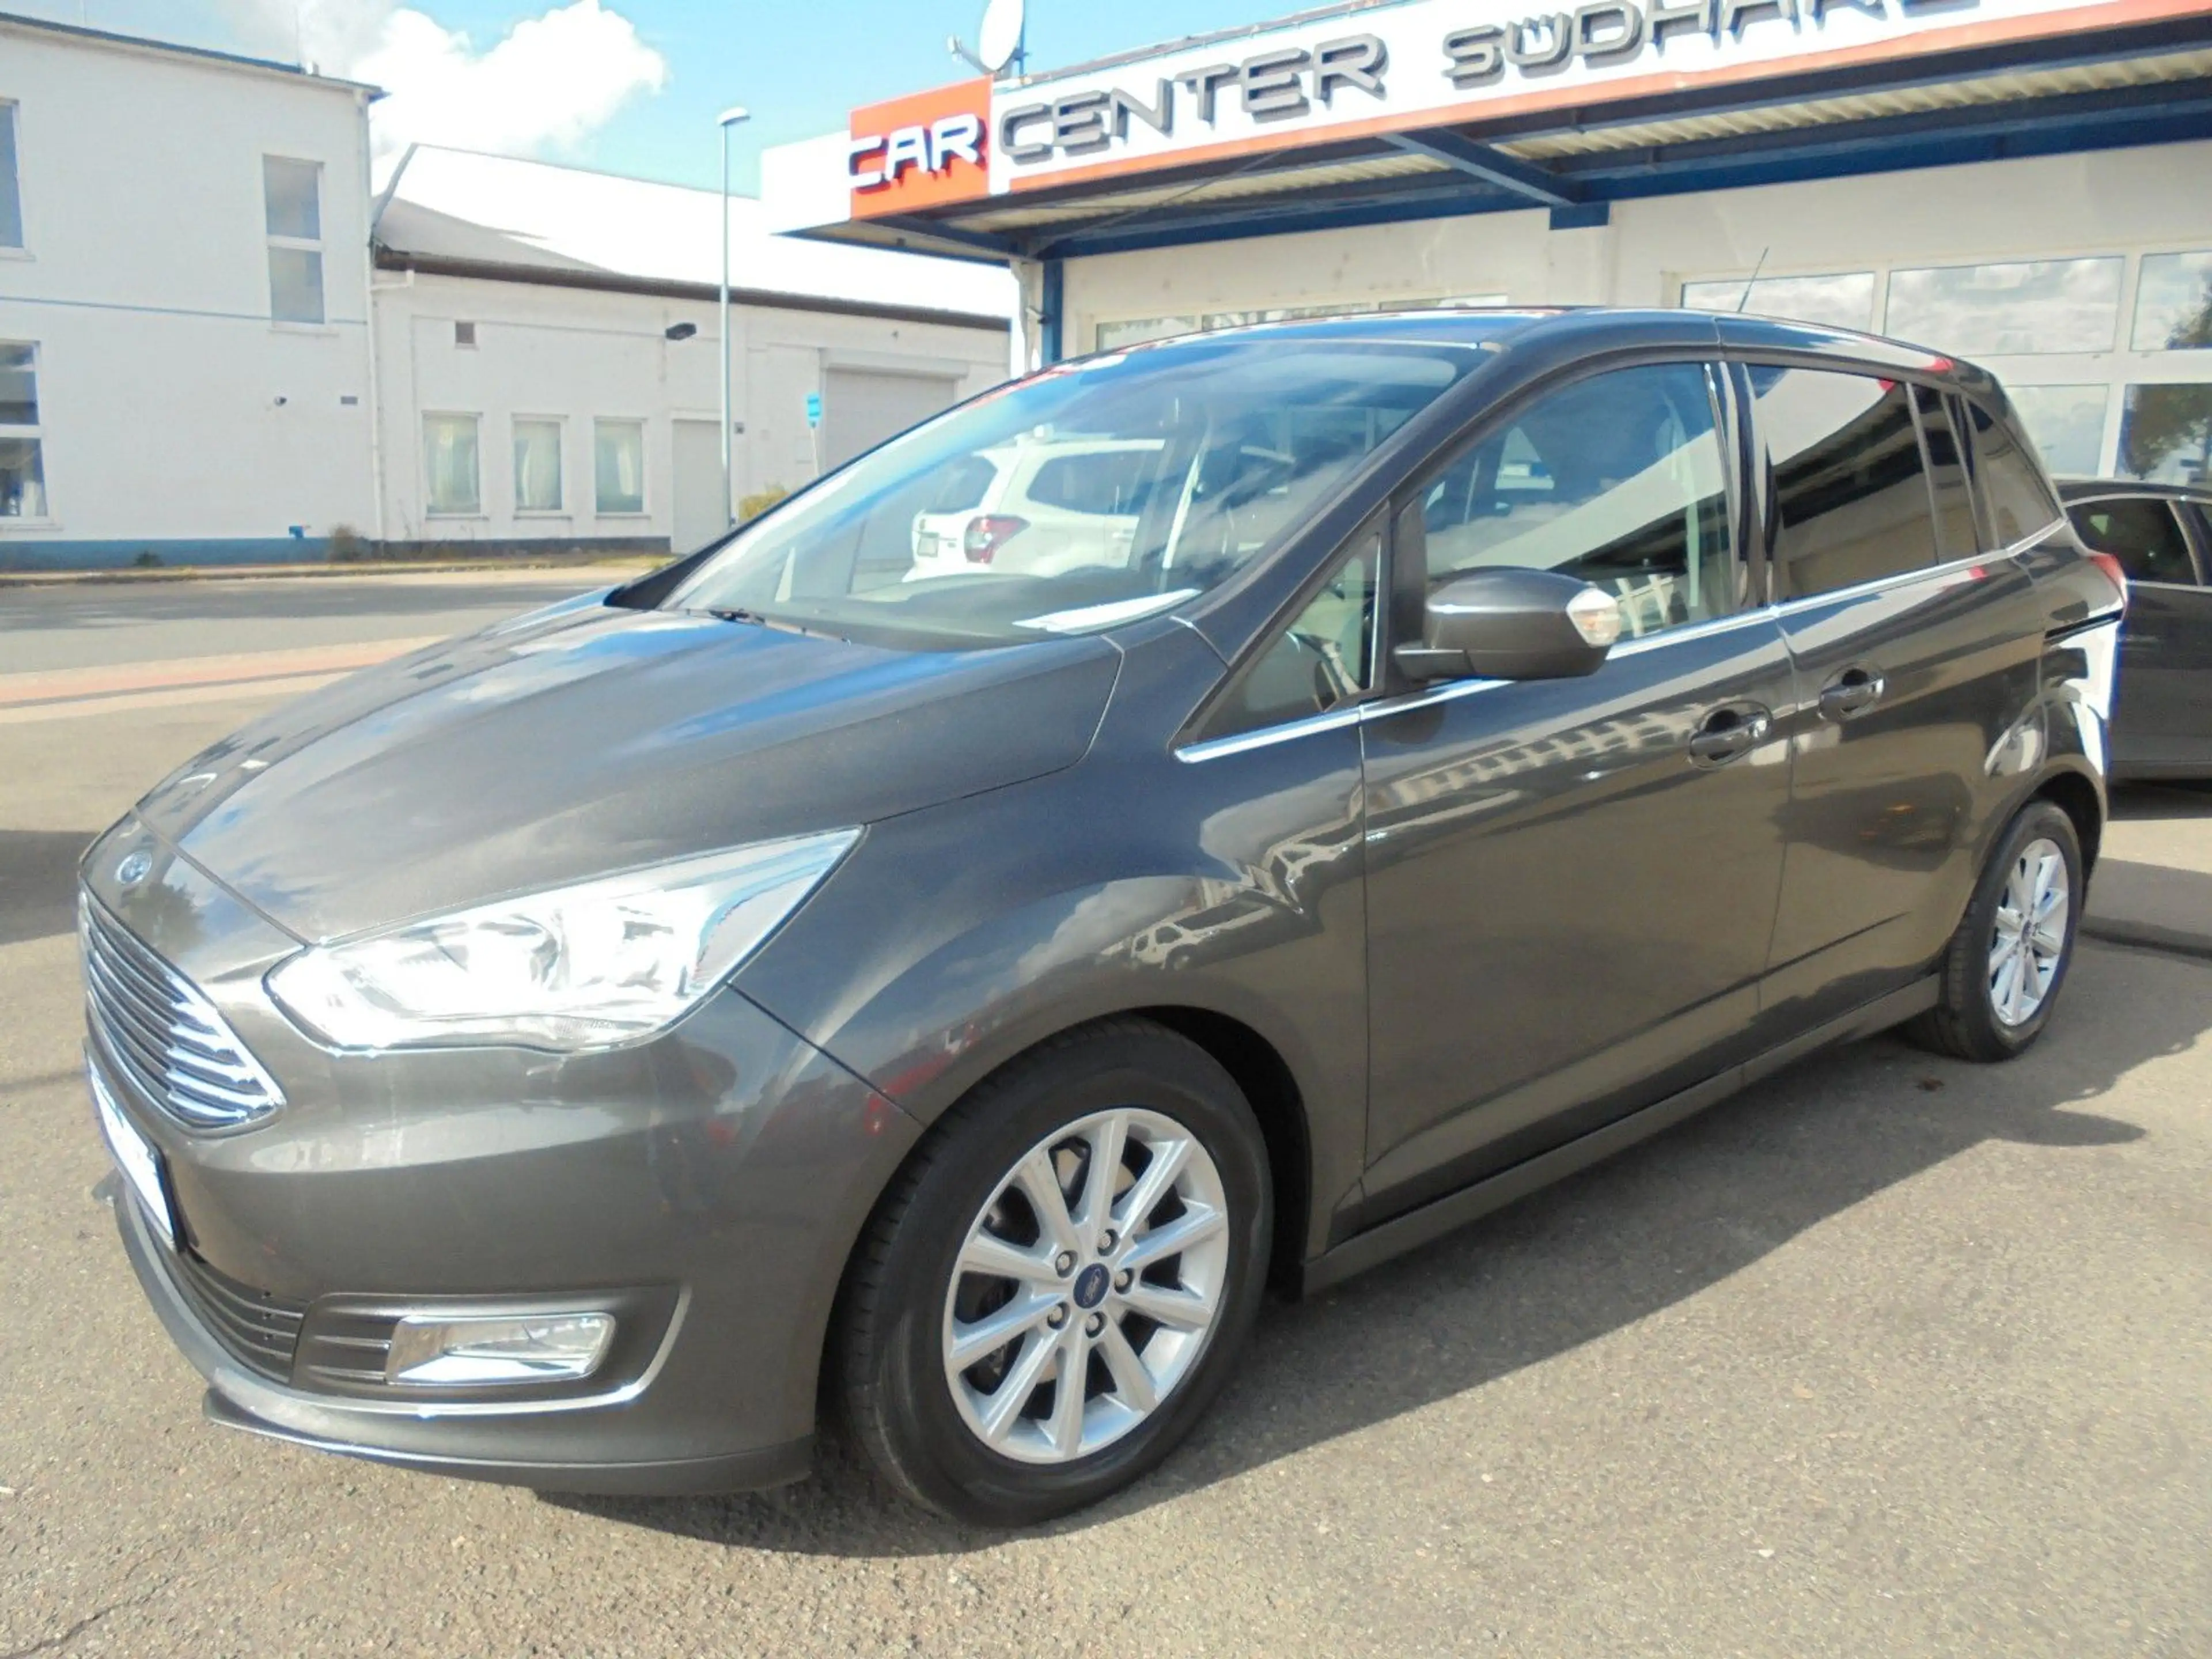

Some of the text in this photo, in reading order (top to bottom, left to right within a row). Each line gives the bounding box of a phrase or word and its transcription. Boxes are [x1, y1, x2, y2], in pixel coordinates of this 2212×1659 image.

[849, 0, 1980, 192] CAR CENTER SÜDHA
